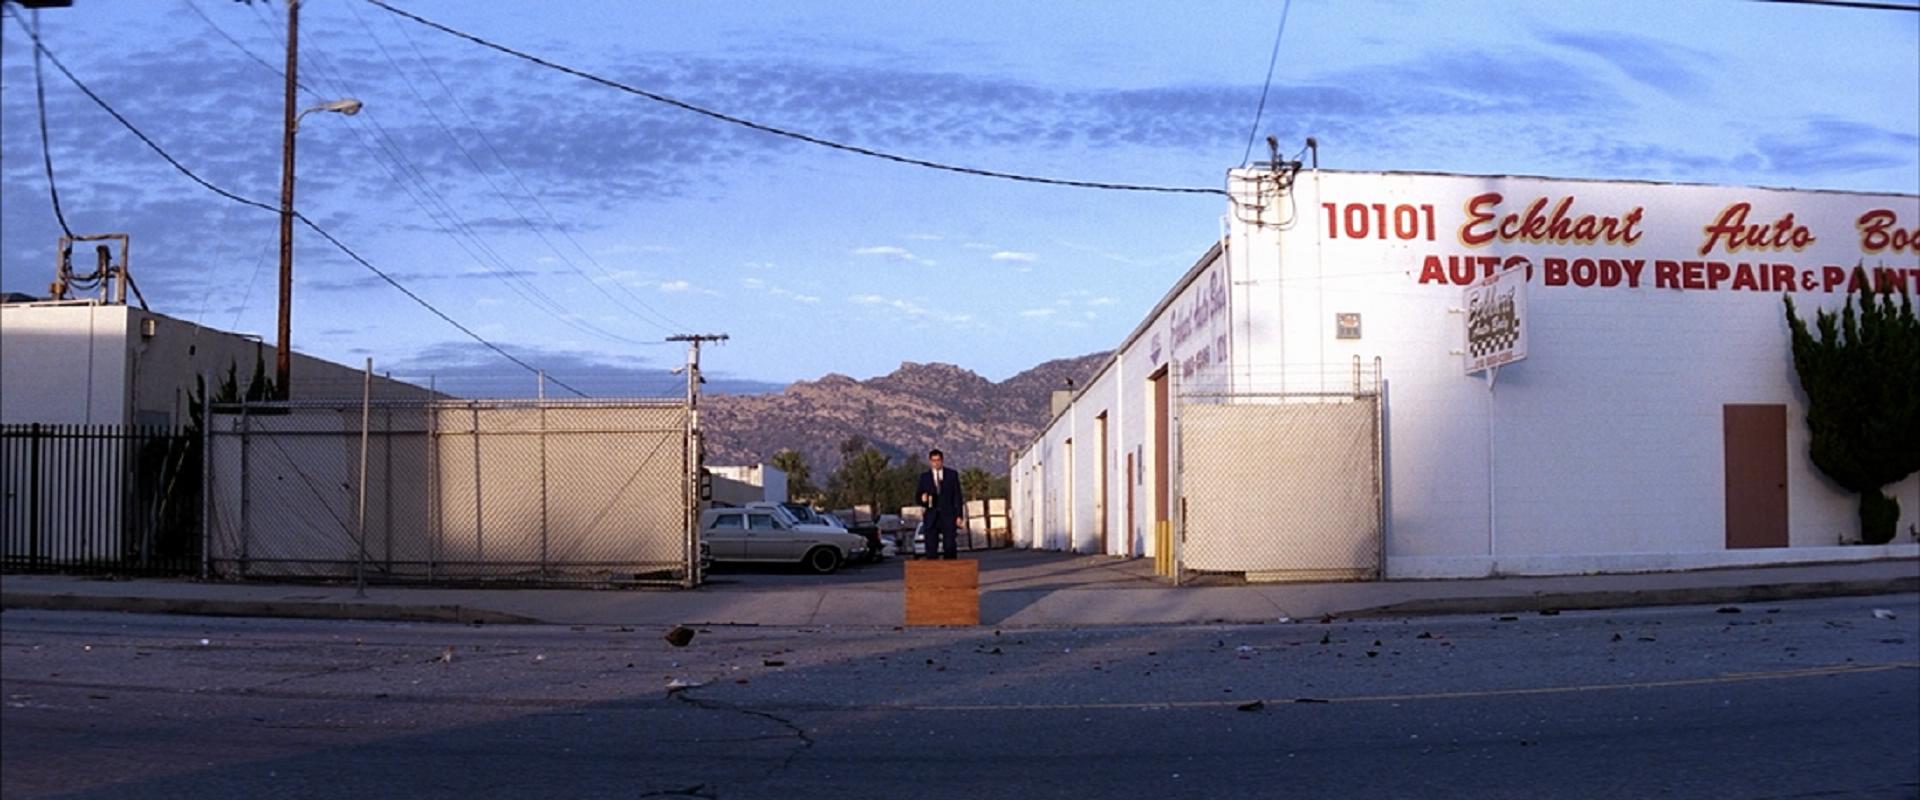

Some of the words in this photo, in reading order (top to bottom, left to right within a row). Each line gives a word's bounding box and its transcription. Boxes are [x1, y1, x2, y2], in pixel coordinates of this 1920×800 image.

[1322, 202, 1436, 241] 10101
[1458, 192, 1644, 246] Eckhart
[1698, 201, 1817, 256] Auto
[1544, 257, 1647, 288] BODY
[1654, 260, 1796, 292] REPAIR
[1802, 270, 1820, 291] &
